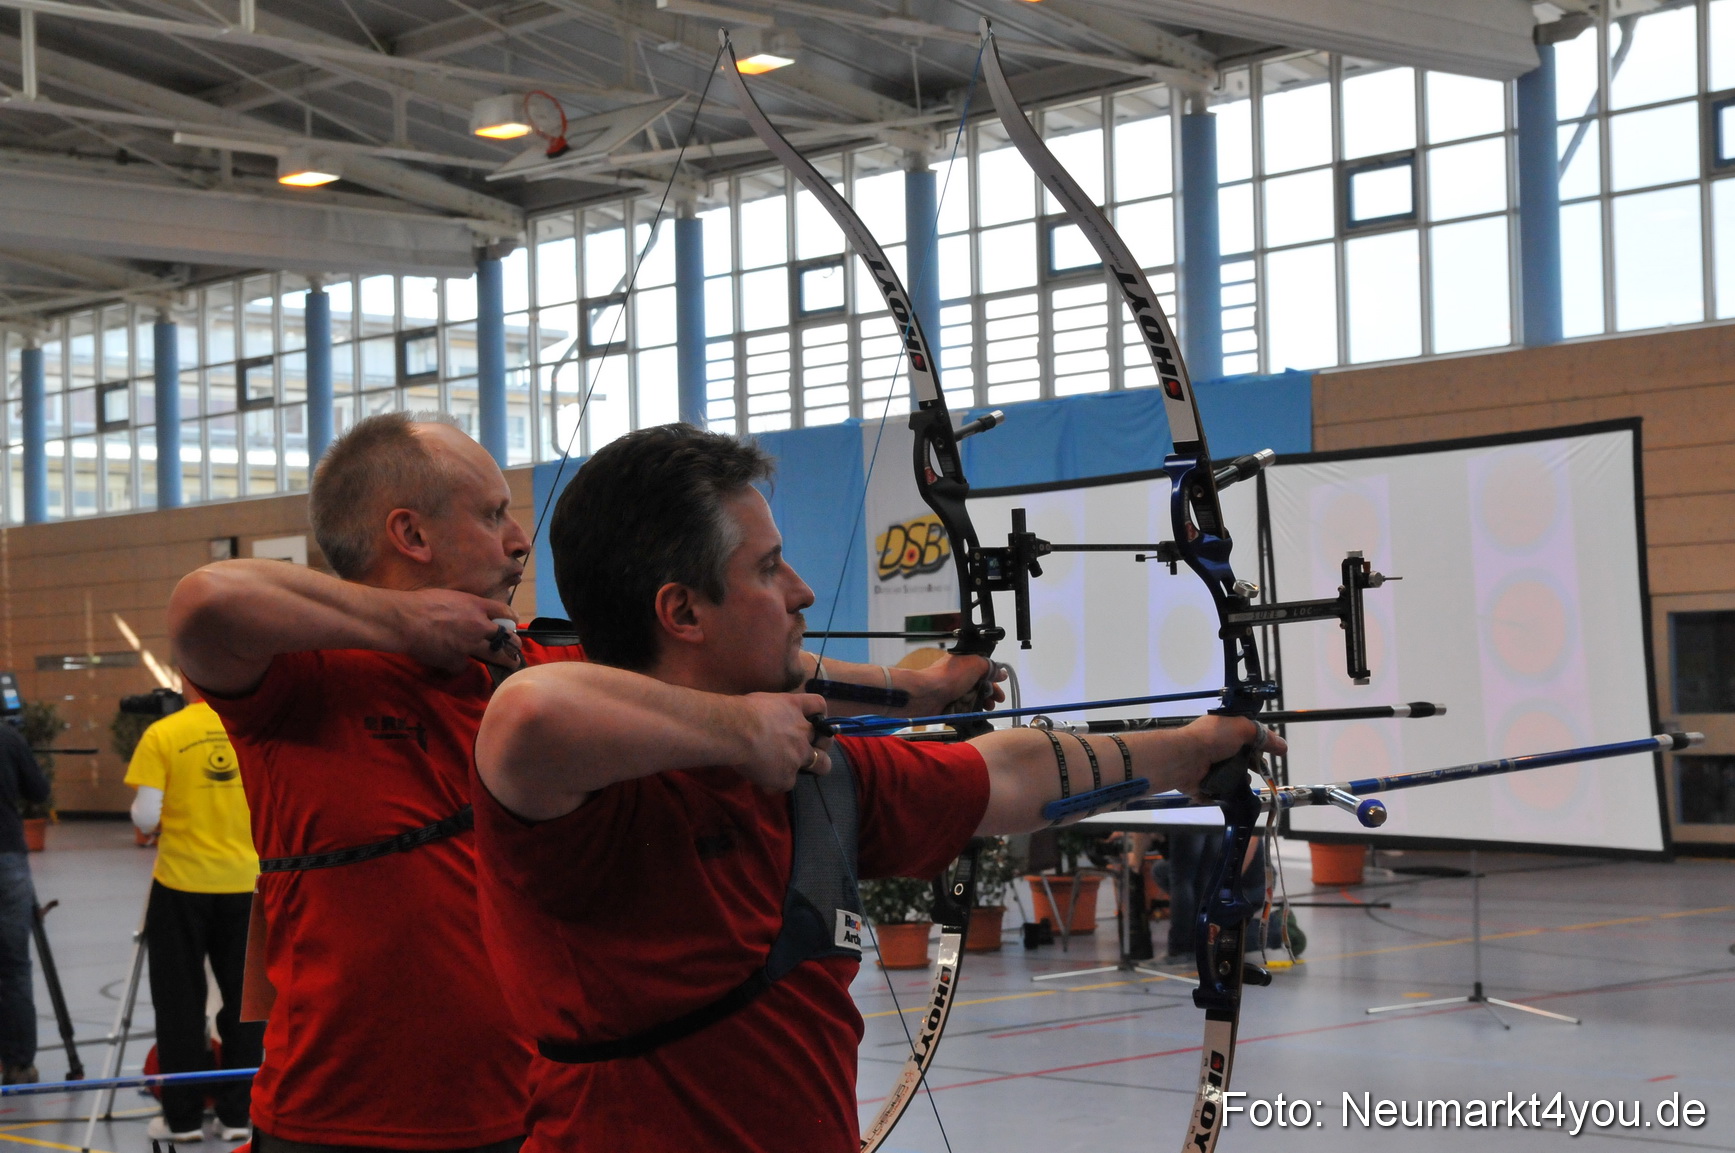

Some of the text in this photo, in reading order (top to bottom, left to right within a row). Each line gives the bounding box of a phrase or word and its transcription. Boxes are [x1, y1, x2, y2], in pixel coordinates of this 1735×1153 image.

[863, 253, 925, 352] HOYT
[1109, 264, 1178, 382] HOYT
[880, 523, 944, 569] DSB
[914, 984, 949, 1071] HOYT
